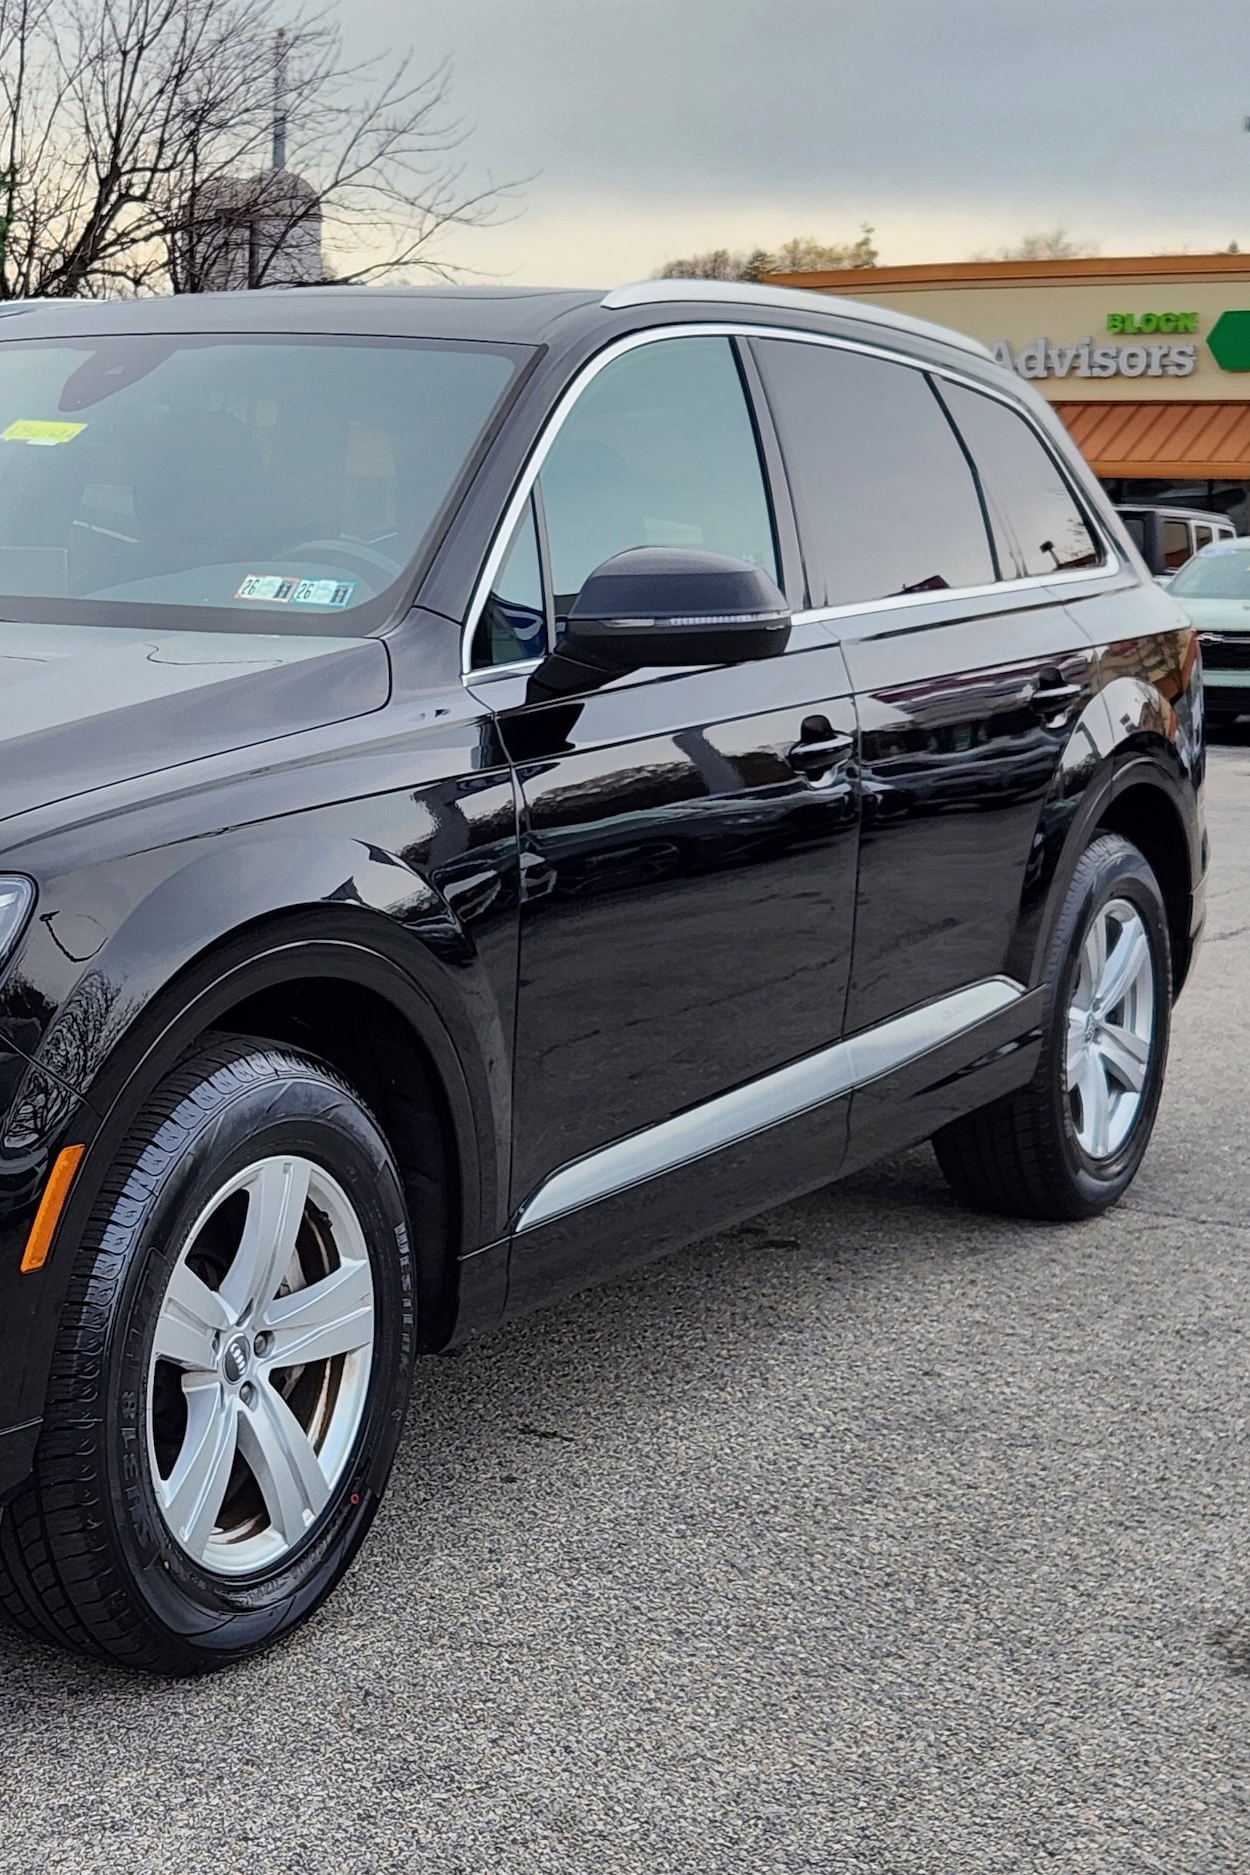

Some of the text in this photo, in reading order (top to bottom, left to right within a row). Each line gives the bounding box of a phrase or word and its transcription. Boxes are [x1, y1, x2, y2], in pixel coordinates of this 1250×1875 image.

[1106, 312, 1198, 334] BLOCK
[991, 336, 1197, 379] Advisors
[241, 579, 260, 596] 26
[296, 583, 314, 600] 26
